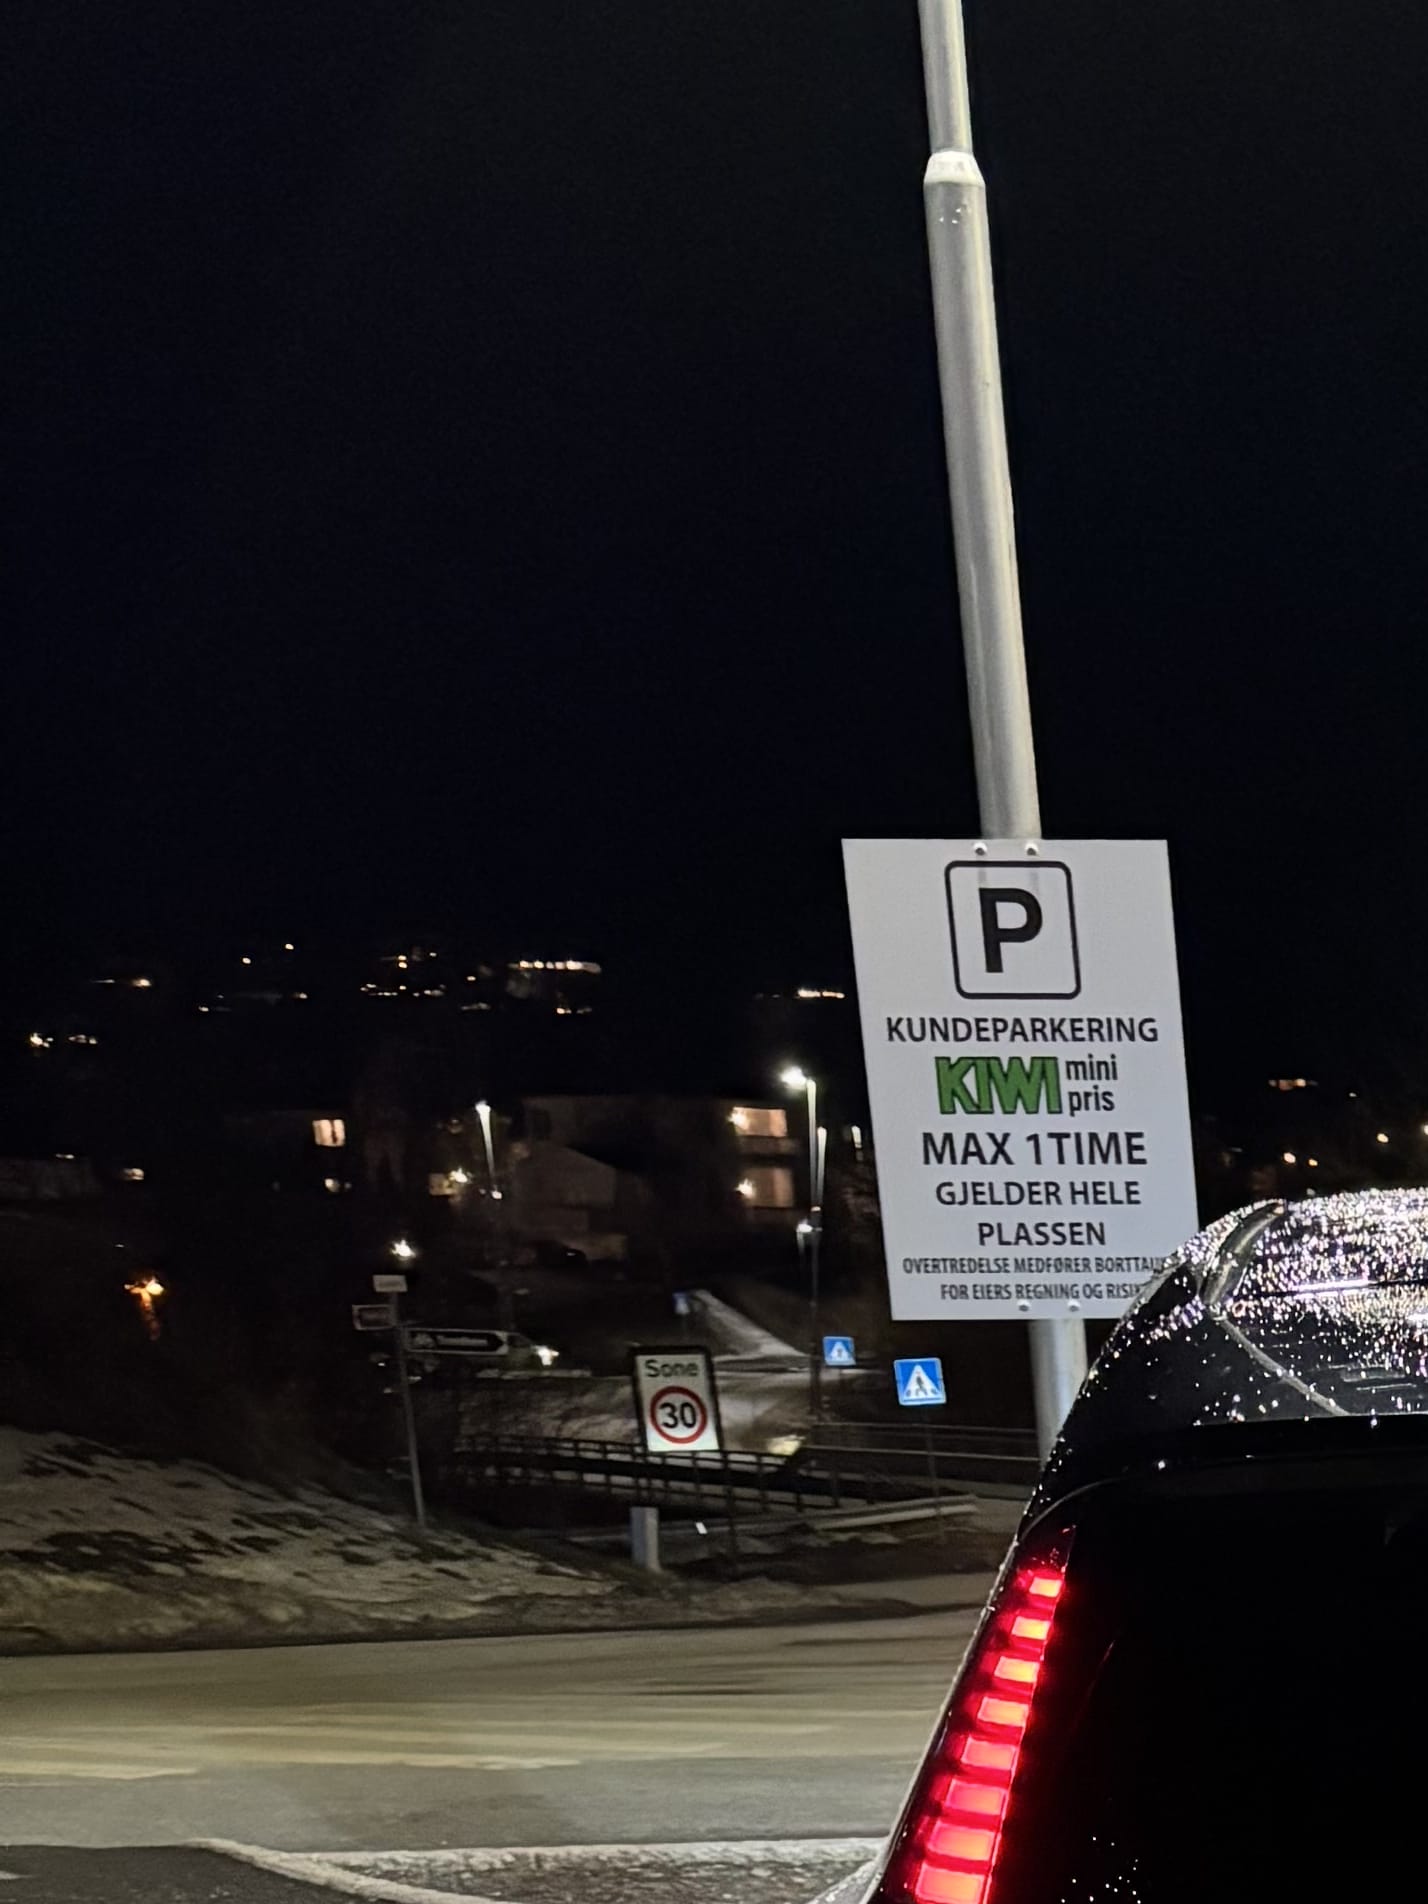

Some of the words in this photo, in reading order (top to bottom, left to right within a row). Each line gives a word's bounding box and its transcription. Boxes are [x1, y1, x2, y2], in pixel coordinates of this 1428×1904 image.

[978, 887, 1043, 974] P
[886, 1016, 1159, 1043] KUNDEPARKERING
[934, 1055, 1064, 1115] KIWI
[1065, 1053, 1118, 1081] mini
[1067, 1084, 1115, 1118] pris
[922, 1131, 1015, 1166] MAX
[935, 1181, 1063, 1206] GJELDER
[1069, 1180, 1142, 1205] HELE
[977, 1221, 1106, 1246] PLASSEN
[903, 1257, 1011, 1274] OVERTREDELSE
[1014, 1256, 1092, 1273] MEDFØRER
[940, 1283, 969, 1300] FOR
[972, 1283, 1012, 1300] EIERS
[1015, 1283, 1080, 1300] REGNING
[1083, 1283, 1104, 1300] OG
[645, 1359, 699, 1378] Sone
[660, 1402, 697, 1429] 30
